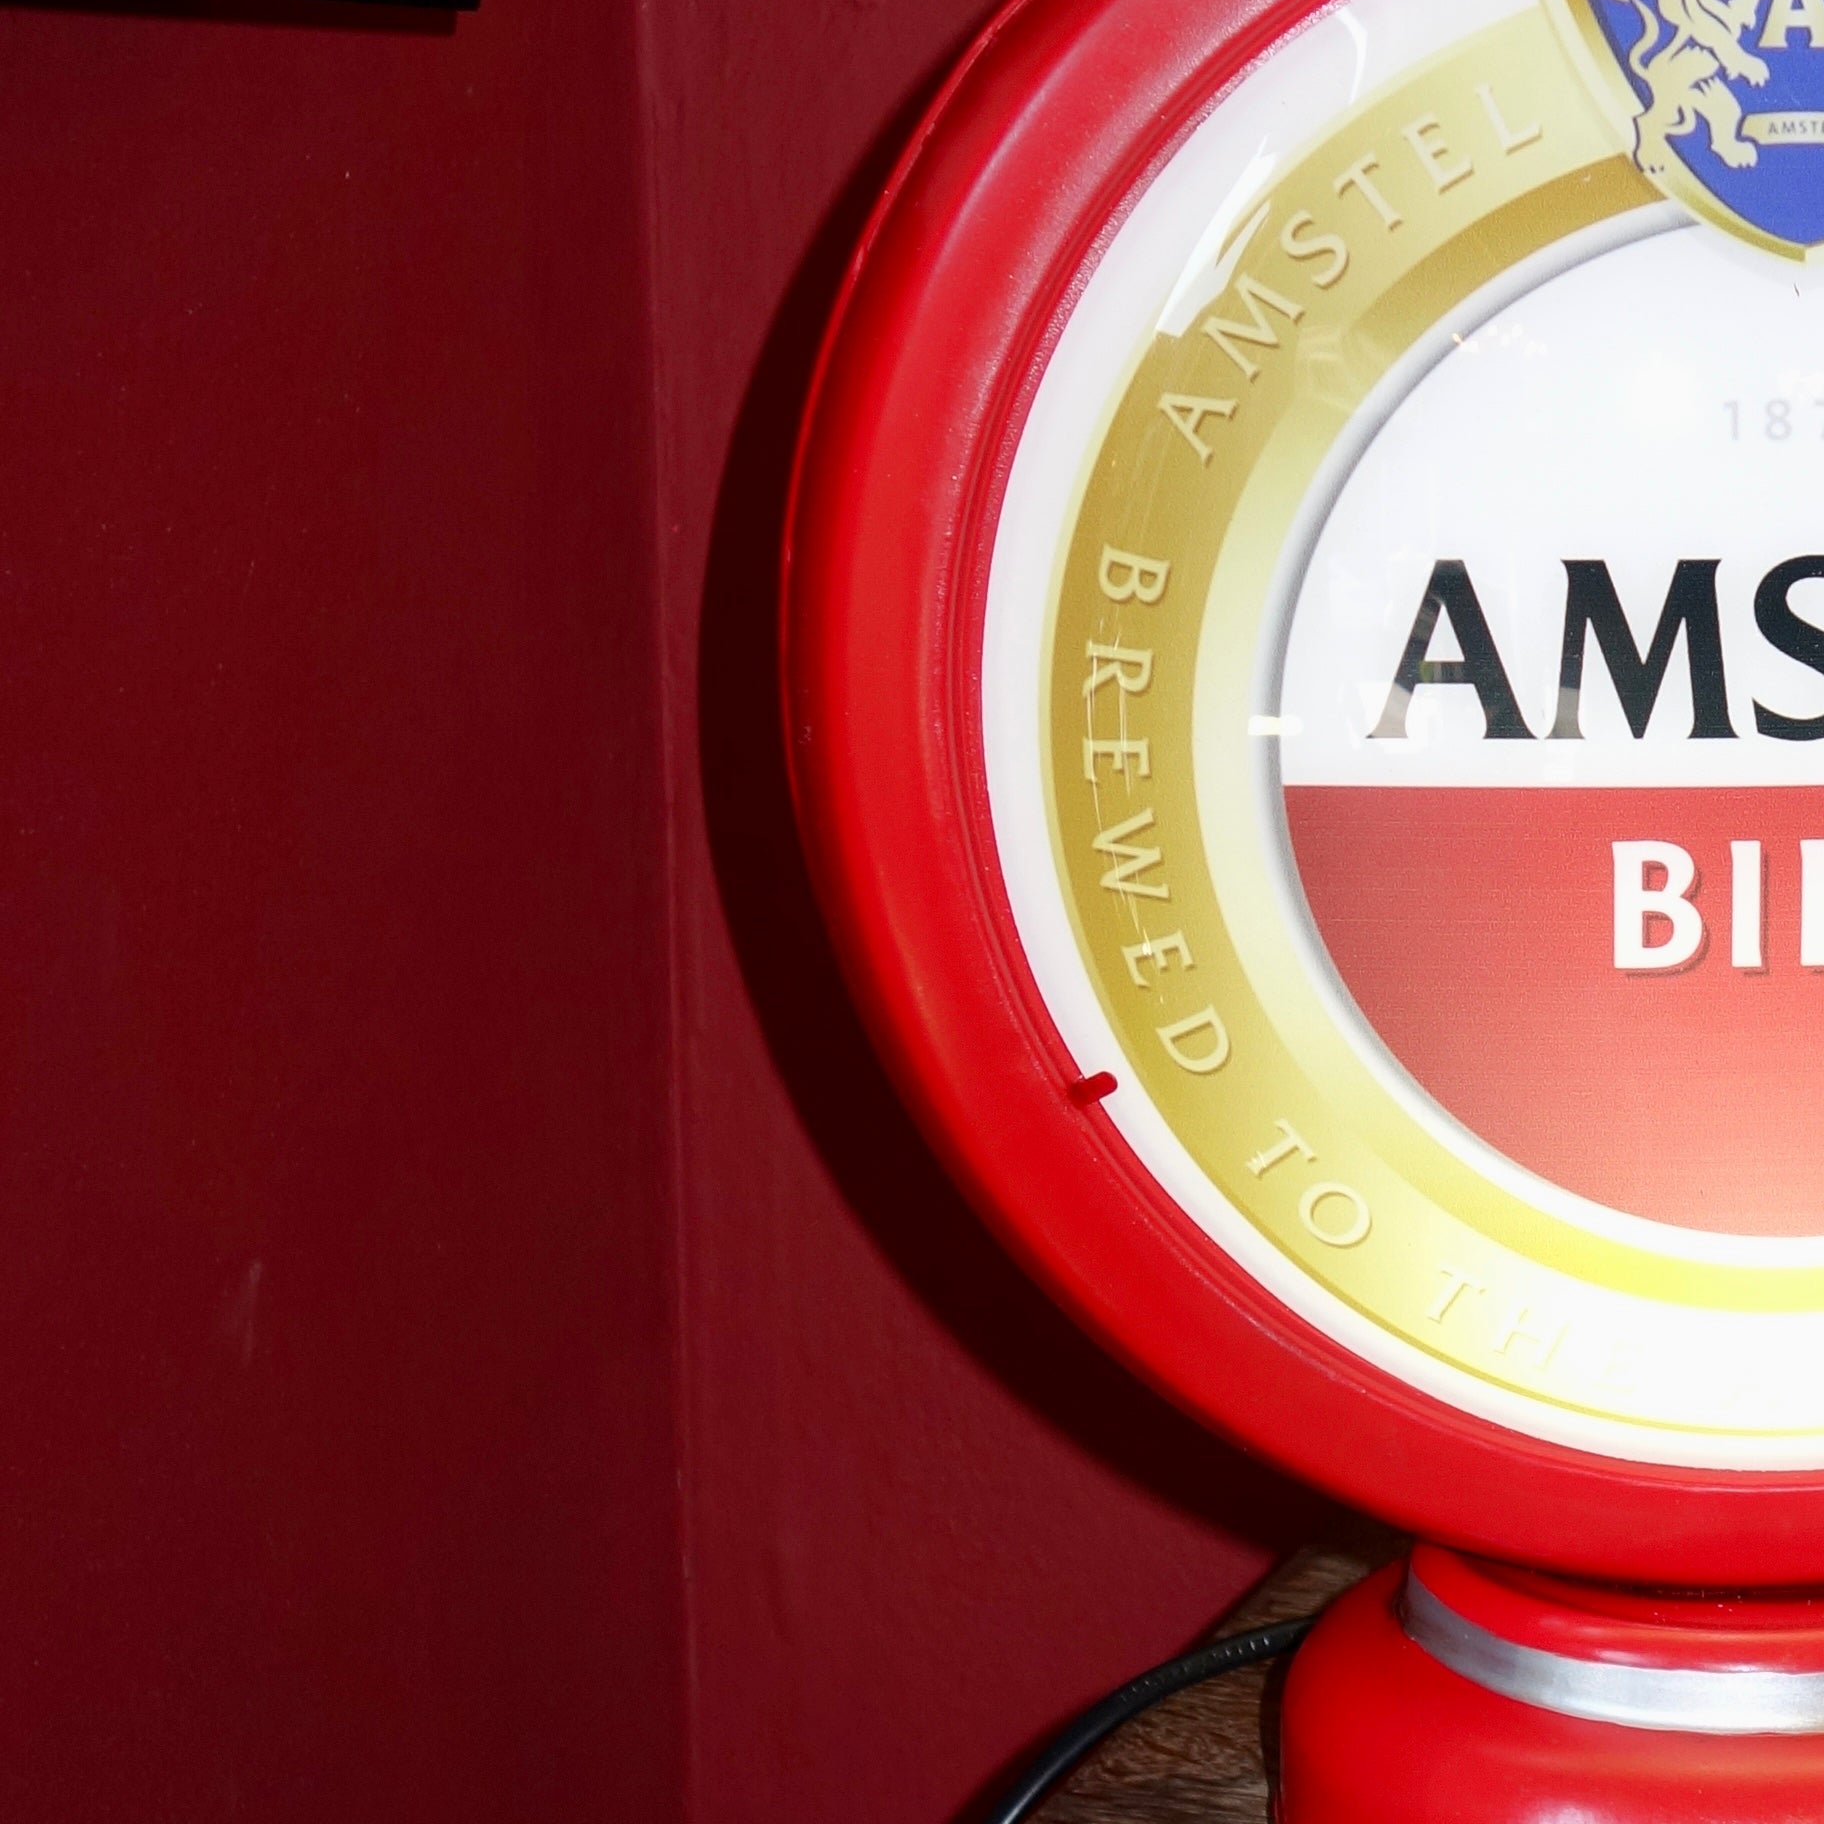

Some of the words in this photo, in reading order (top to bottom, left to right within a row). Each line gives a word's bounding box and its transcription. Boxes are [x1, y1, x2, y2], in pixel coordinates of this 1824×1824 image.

[1156, 82, 1545, 468] AMSTEL
[1081, 543, 1233, 1074] BREWED
[1245, 1118, 1373, 1248] TO
